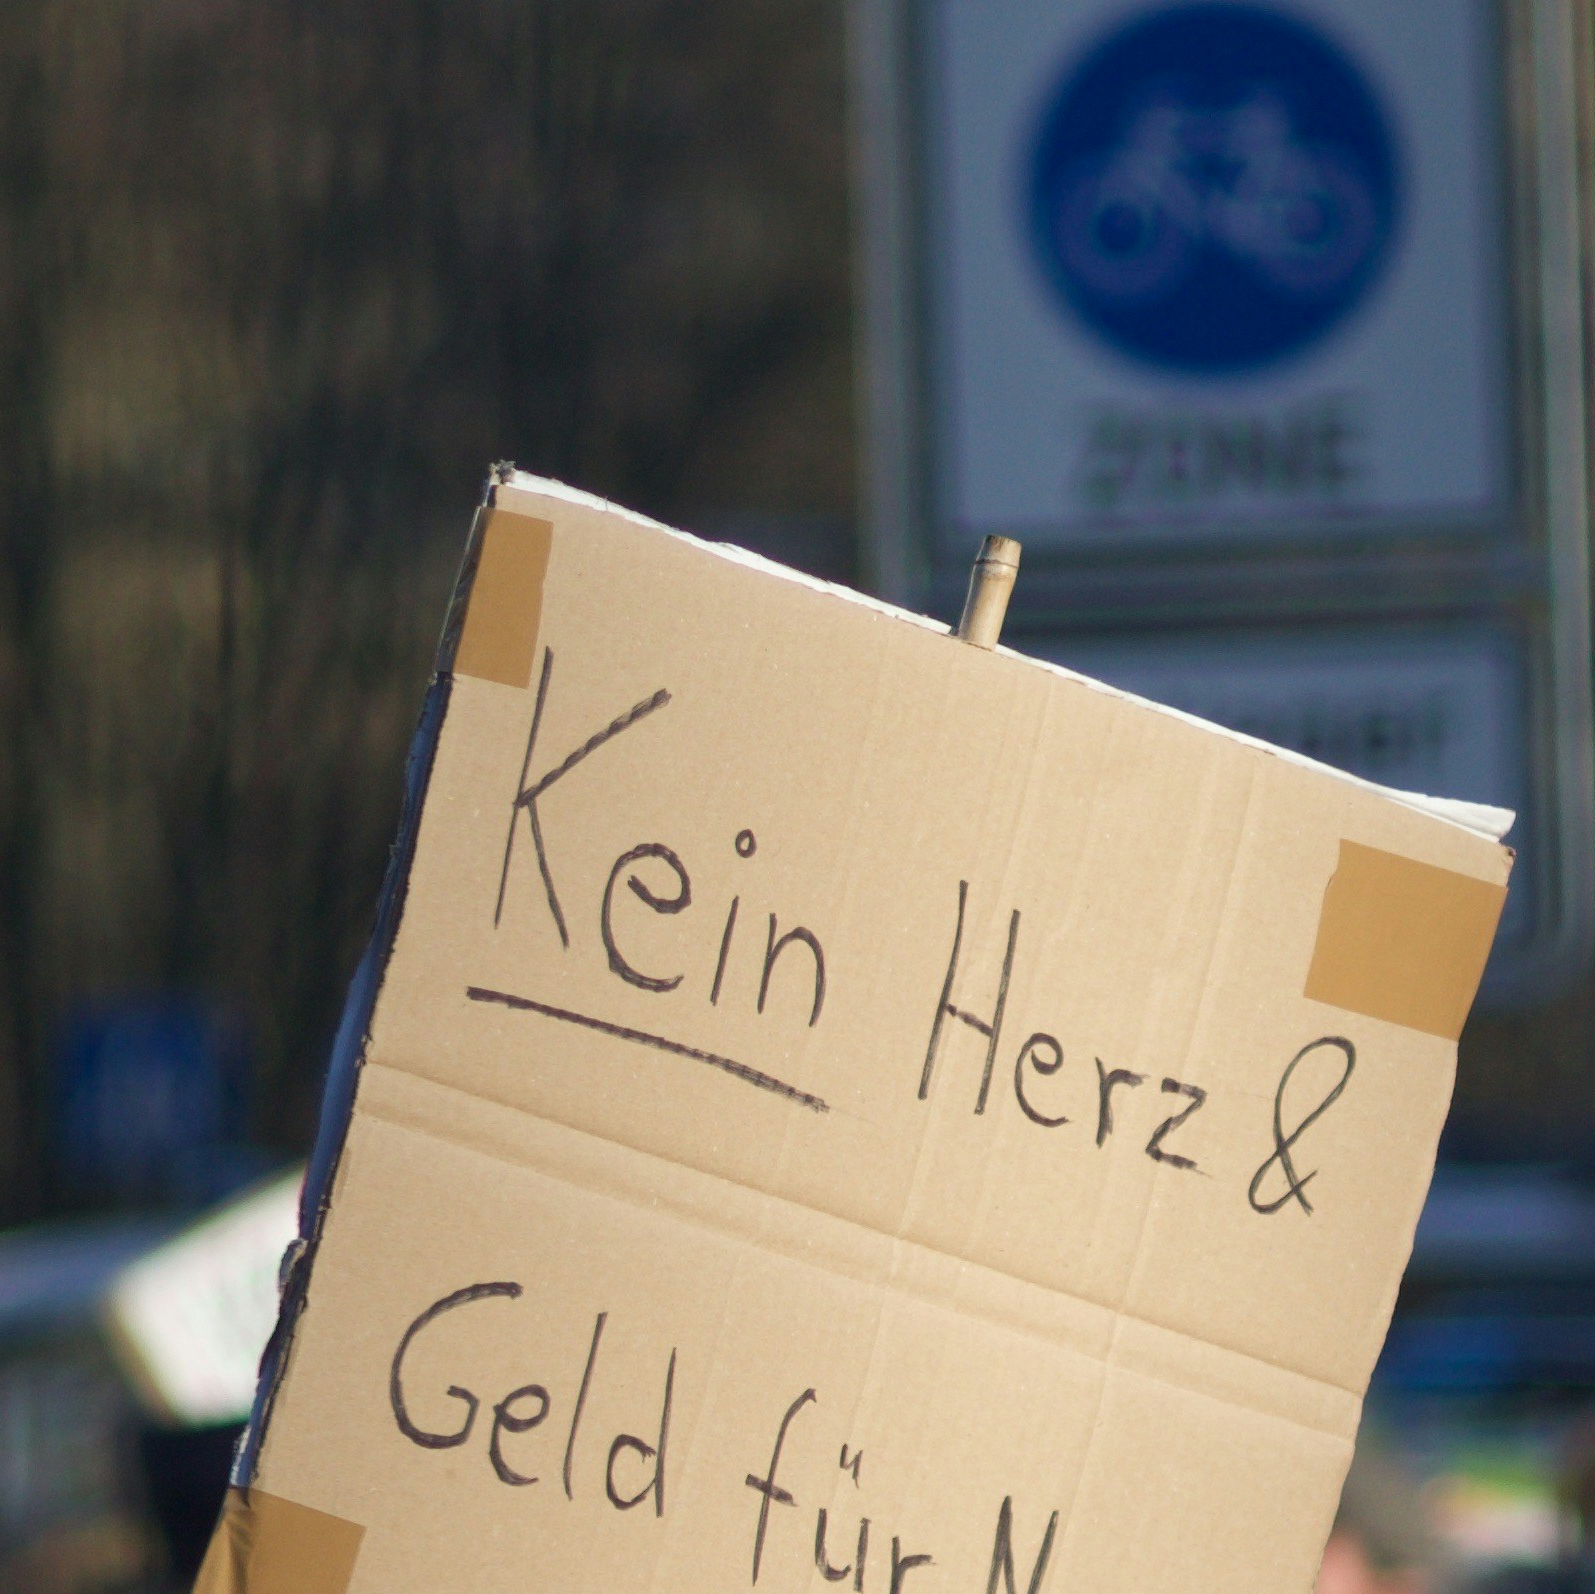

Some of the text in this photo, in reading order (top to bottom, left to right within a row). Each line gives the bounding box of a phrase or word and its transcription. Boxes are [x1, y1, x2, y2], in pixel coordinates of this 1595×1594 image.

[1080, 408, 1364, 506] ZONE
[493, 645, 1358, 1216] Kein Herz &
[388, 1281, 678, 1519] Geld
